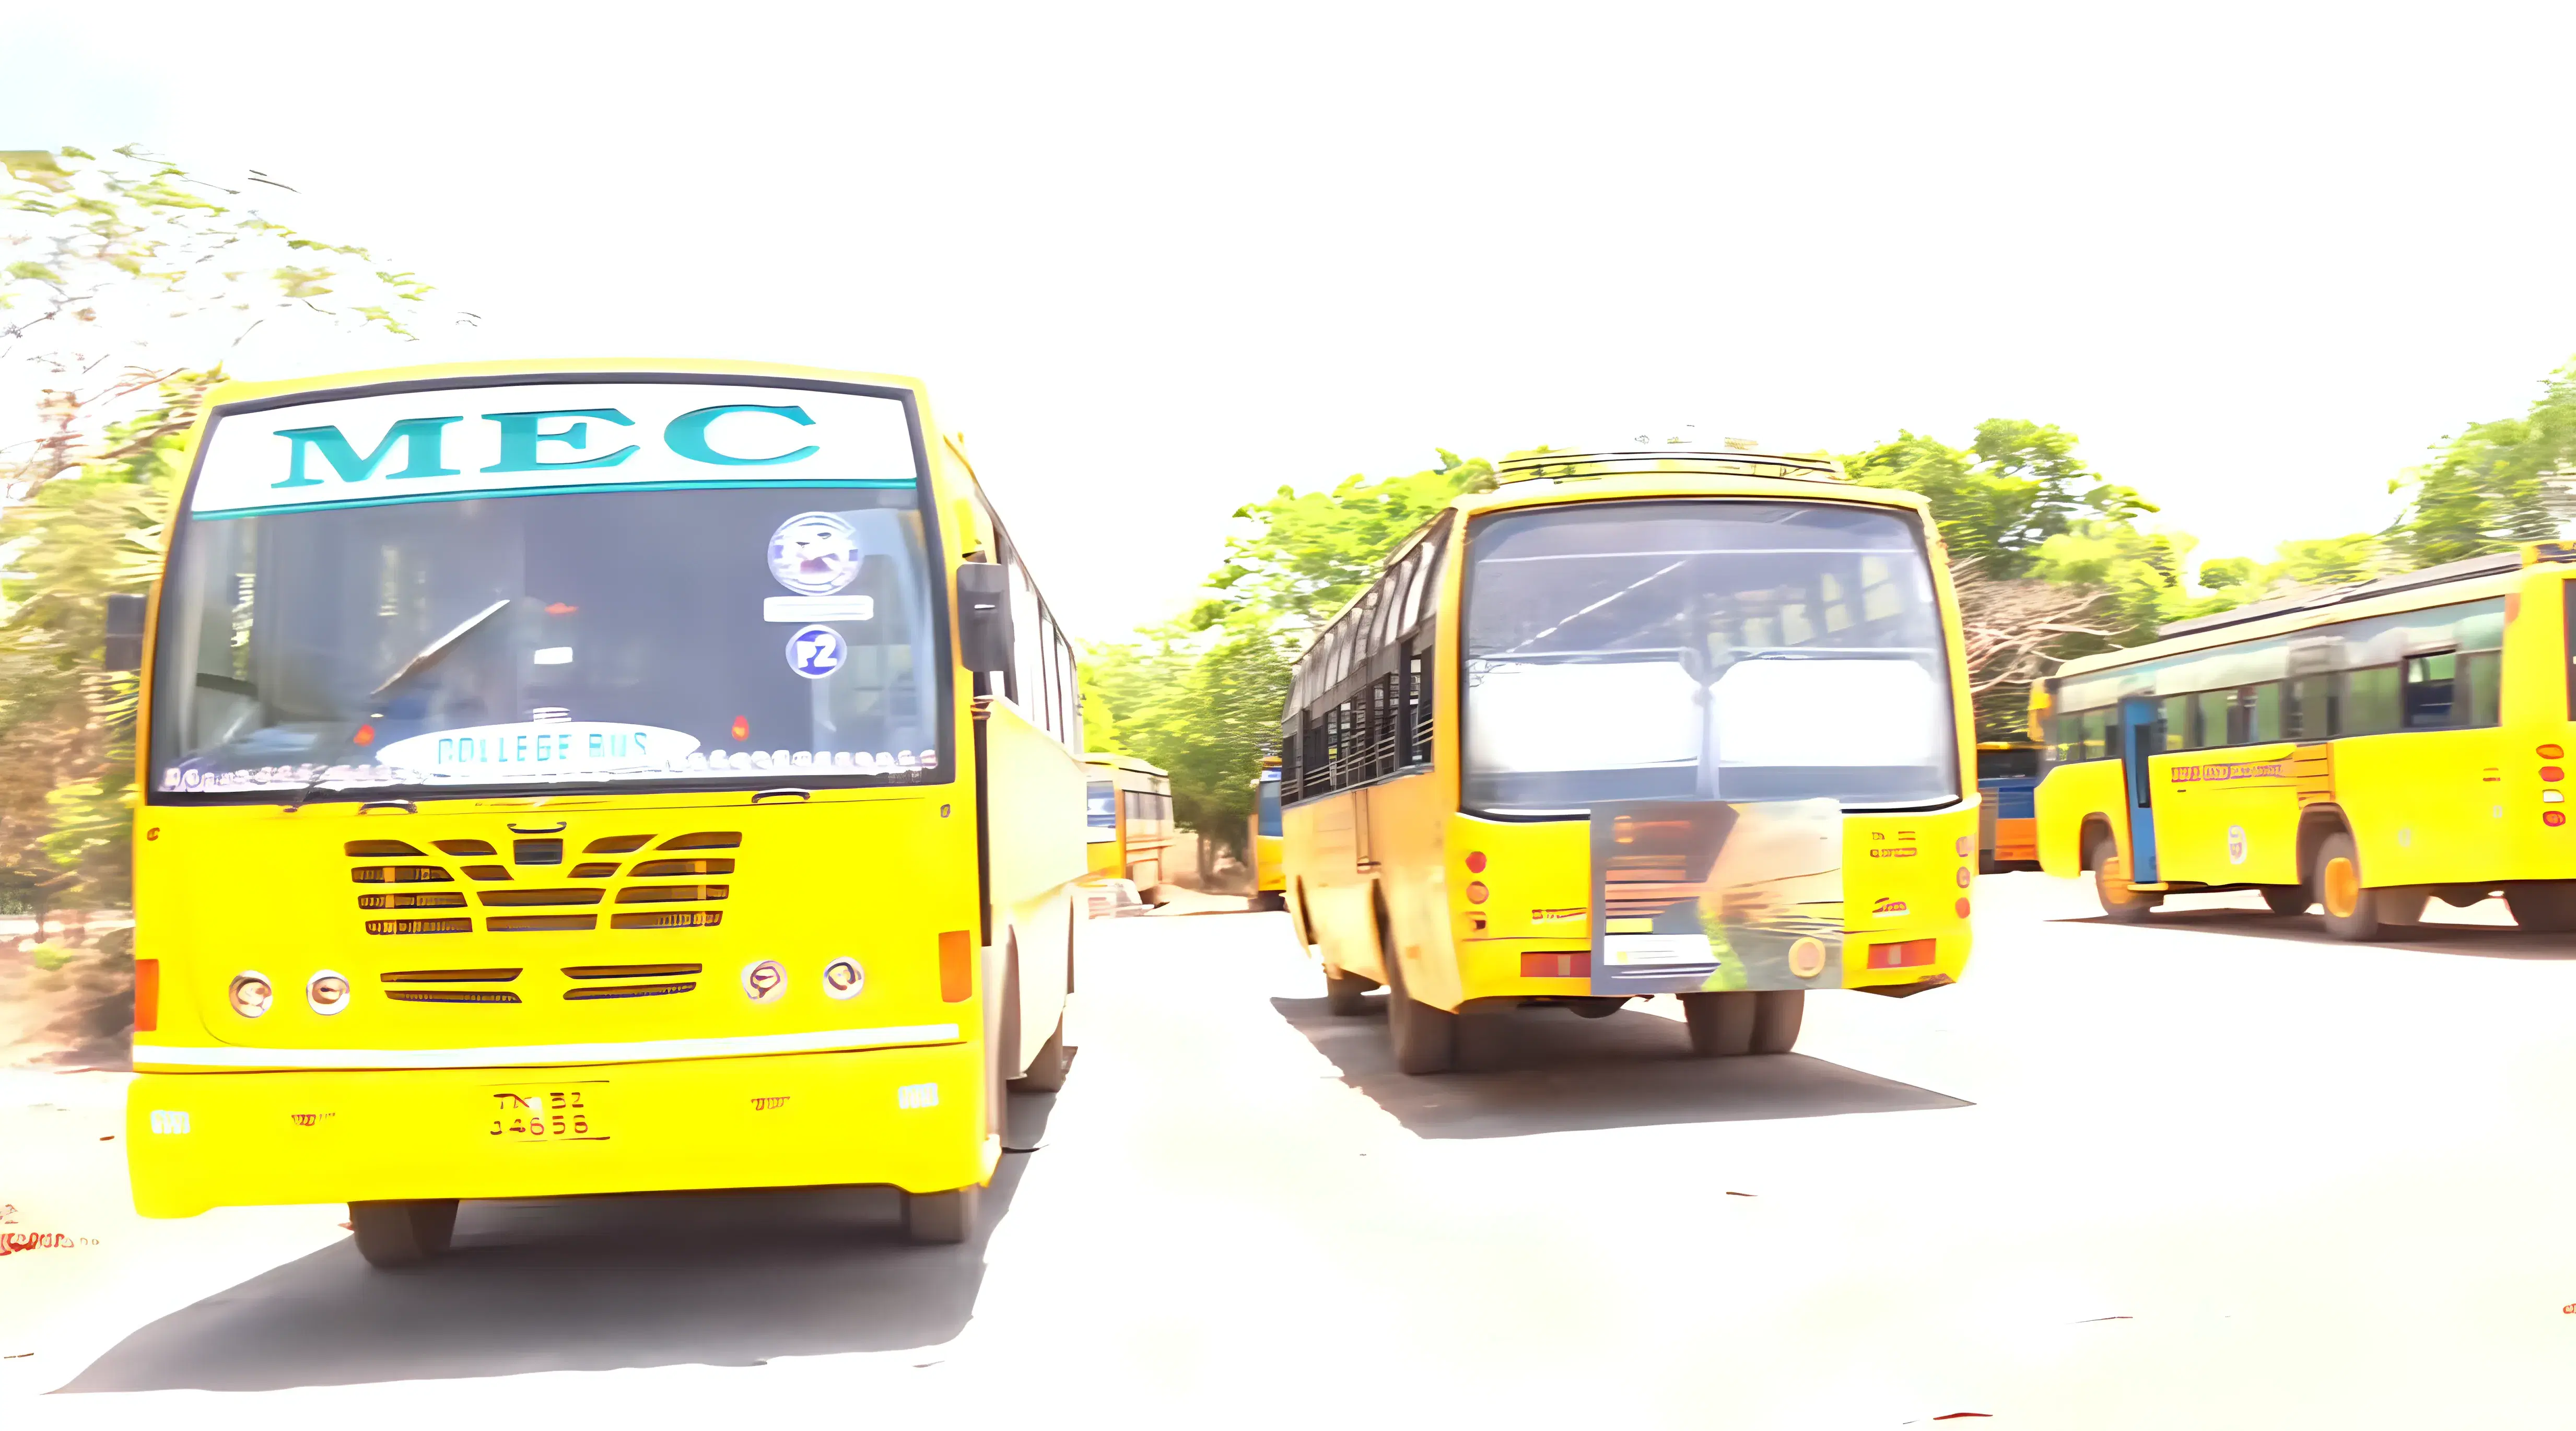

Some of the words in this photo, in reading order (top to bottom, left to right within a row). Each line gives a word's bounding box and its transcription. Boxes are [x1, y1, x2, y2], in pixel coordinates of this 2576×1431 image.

[271, 405, 821, 489] MEC
[438, 734, 572, 765] COLLEGE
[589, 732, 647, 758] BUS
